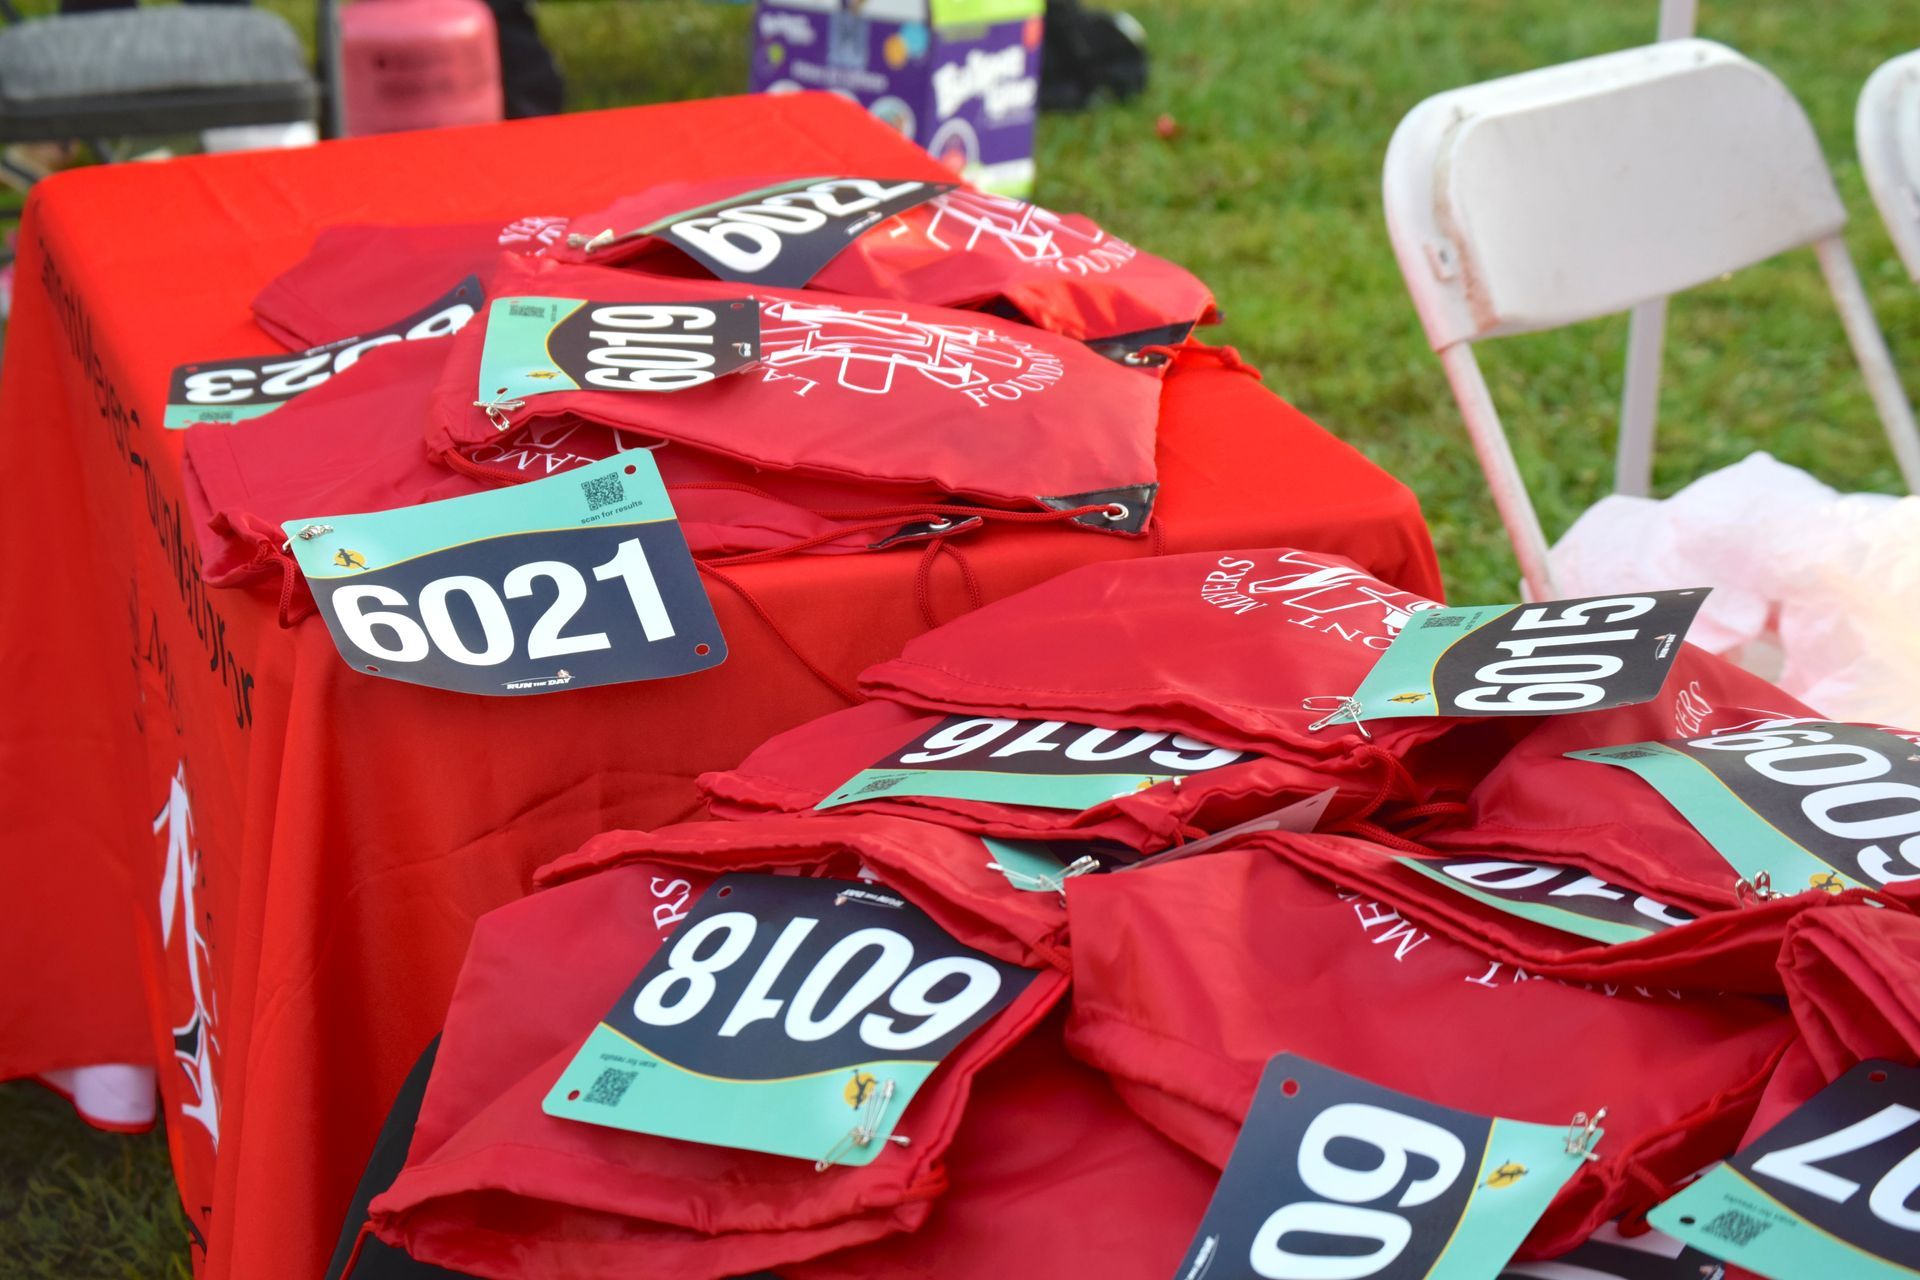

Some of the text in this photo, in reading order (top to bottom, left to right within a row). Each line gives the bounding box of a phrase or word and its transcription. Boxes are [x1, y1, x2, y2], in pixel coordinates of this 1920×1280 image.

[671, 178, 924, 273] 6022
[584, 304, 717, 391] 6019
[581, 500, 643, 524] scan for results
[331, 537, 676, 666] 6021
[1201, 556, 1268, 615] MEYERS
[1454, 596, 1657, 713] 6015
[633, 911, 1002, 1051] 6018
